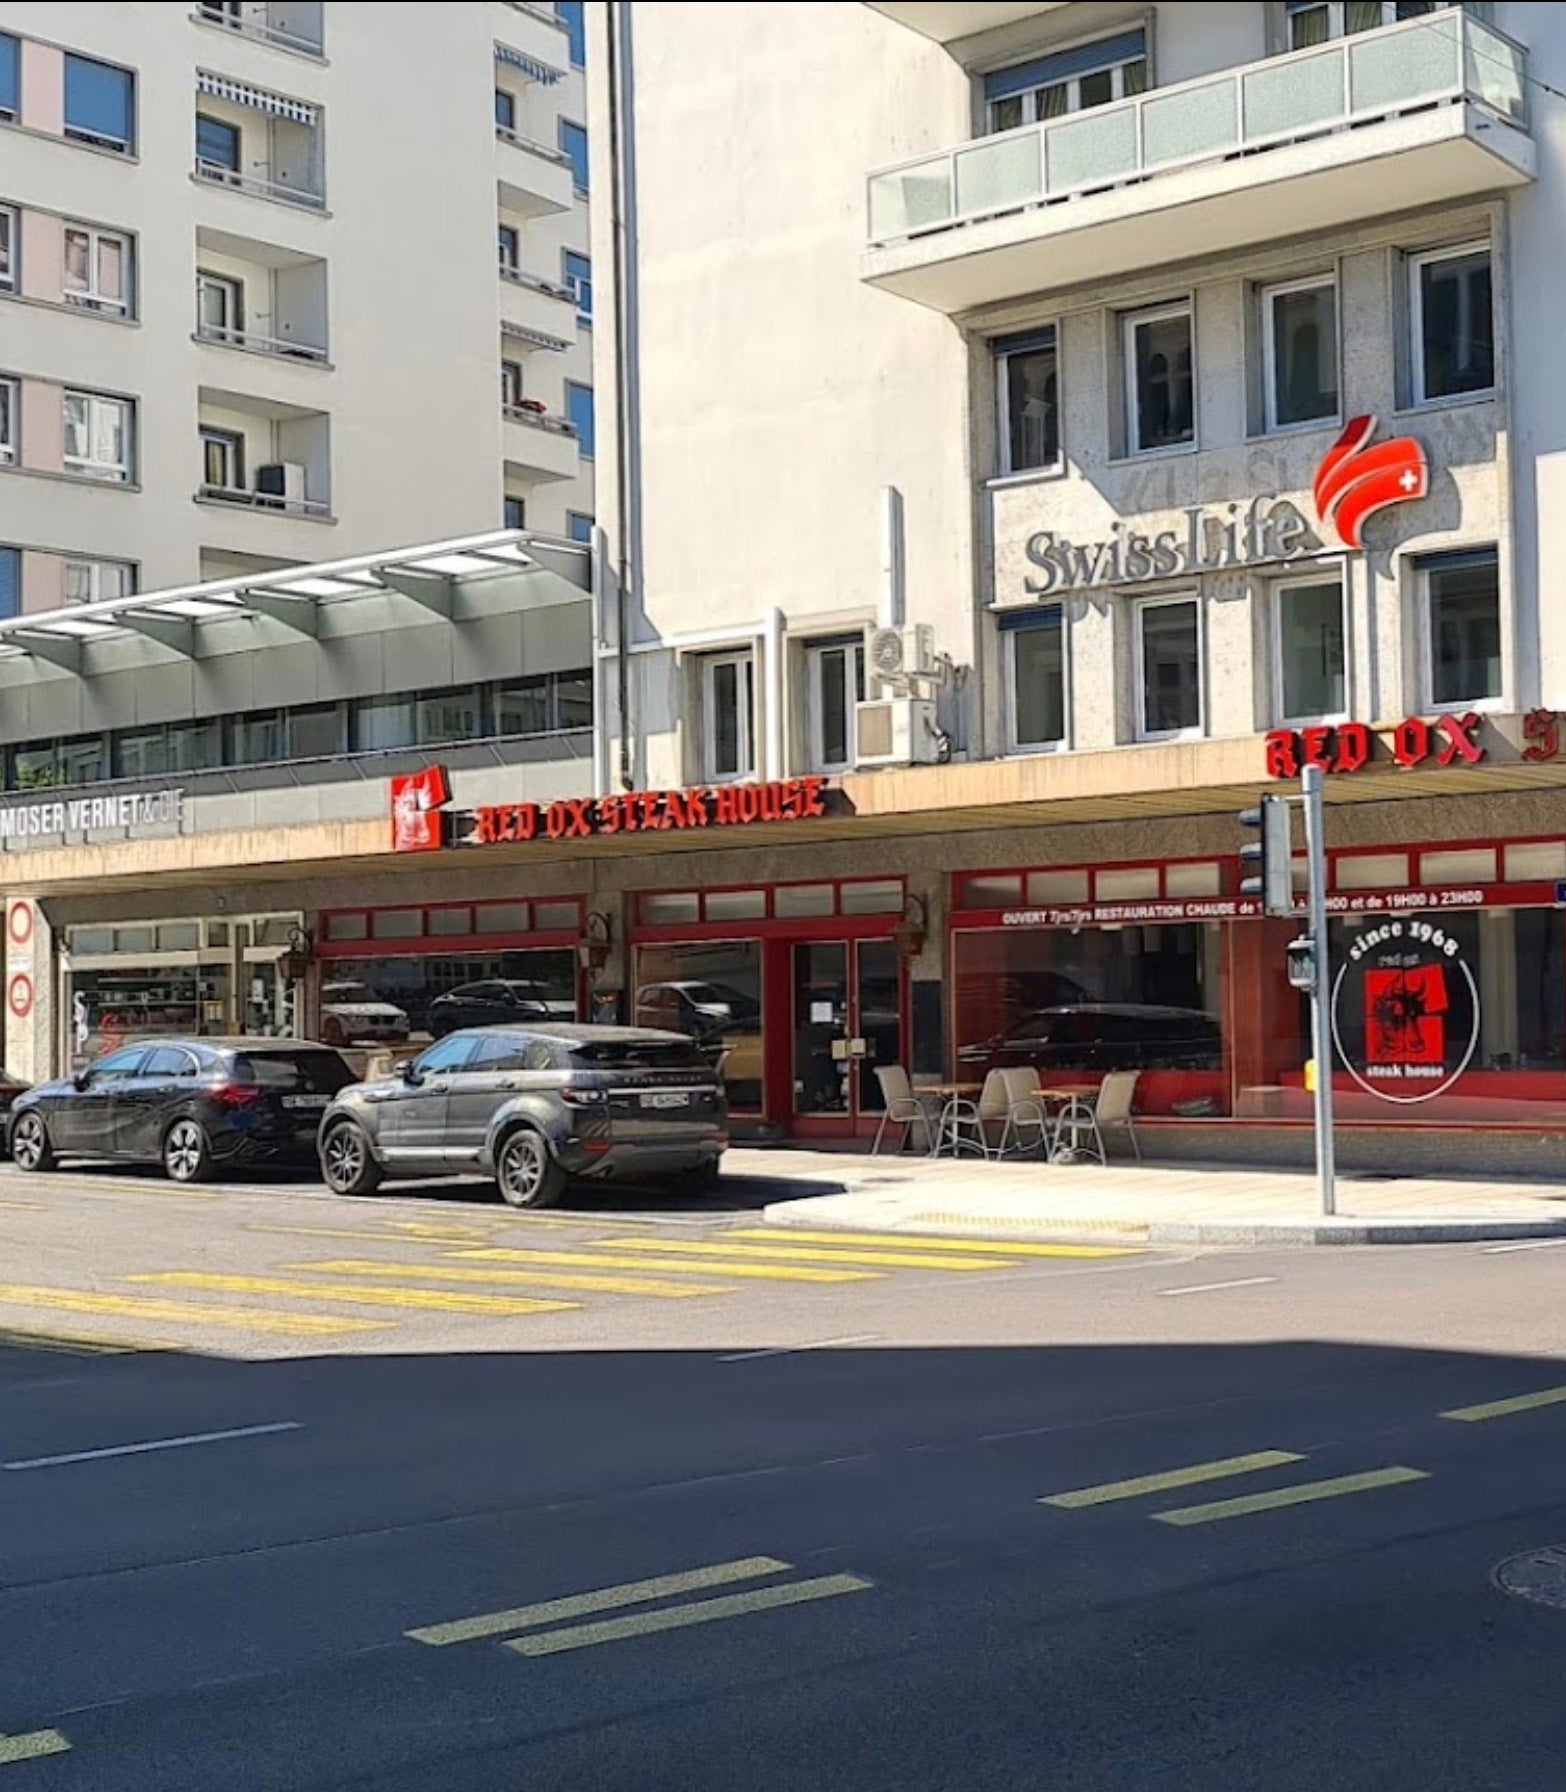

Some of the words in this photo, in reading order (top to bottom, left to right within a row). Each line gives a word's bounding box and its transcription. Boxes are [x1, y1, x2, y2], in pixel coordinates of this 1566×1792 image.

[1265, 718, 1371, 778] RED
[1394, 709, 1486, 768] OX
[0, 802, 65, 837] MOSER
[68, 793, 142, 831] VERNET
[143, 793, 156, 824] &
[476, 802, 539, 844] RED
[546, 797, 595, 840] OX
[599, 787, 709, 835] STEAK
[714, 775, 828, 825] HOUSE
[1002, 910, 1047, 926] OUVERT
[1094, 904, 1184, 921] RESTAURATION
[1186, 901, 1235, 917] CHAUDE
[1239, 901, 1255, 915] de
[1351, 896, 1364, 909] et
[1366, 895, 1383, 909] de
[1386, 892, 1426, 908] 19H00
[1441, 890, 1485, 905] 23H00
[1351, 922, 1402, 960] since
[1409, 921, 1459, 957] 1968
[1366, 1063, 1403, 1078] steak
[1404, 1063, 1444, 1078] house
